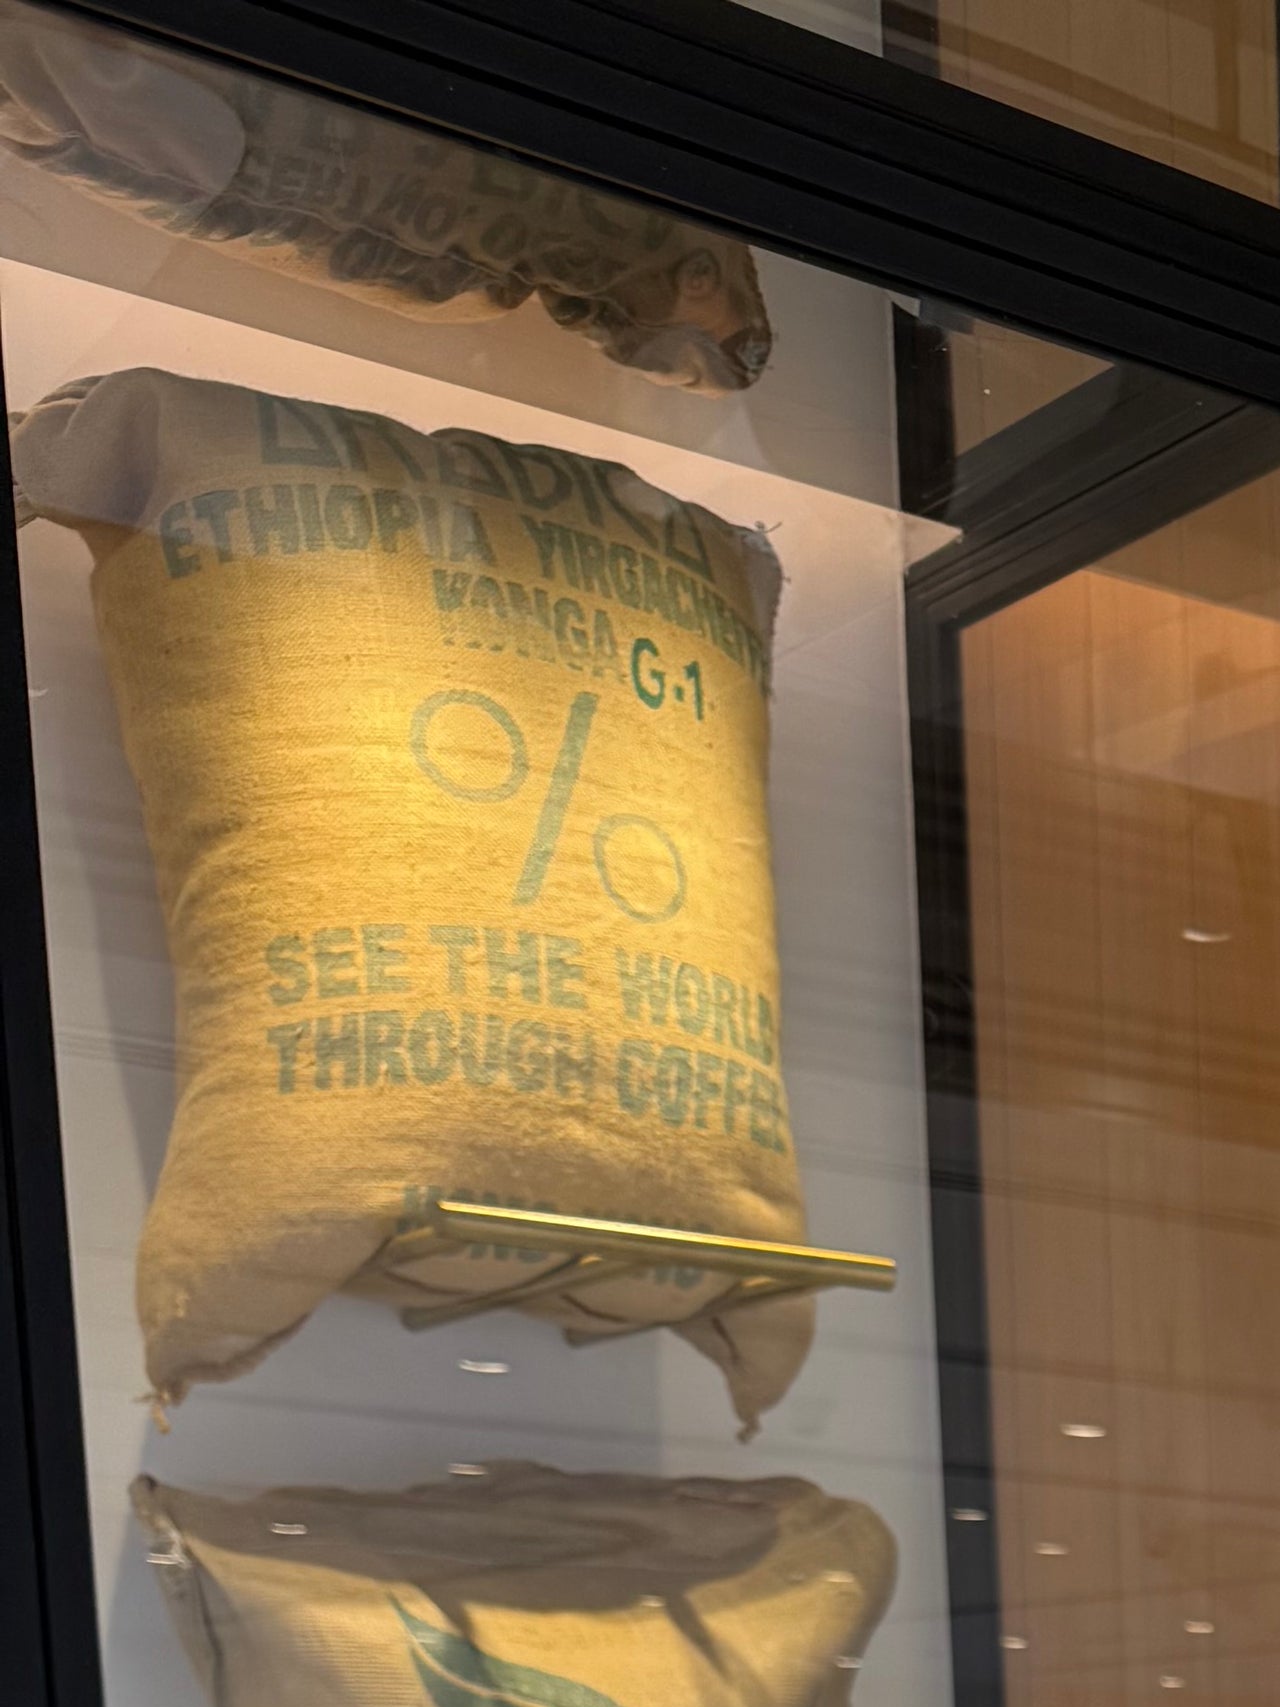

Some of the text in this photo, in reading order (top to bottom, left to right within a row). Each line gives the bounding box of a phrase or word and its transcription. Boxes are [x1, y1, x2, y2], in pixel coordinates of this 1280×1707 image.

[158, 482, 496, 580] ETHIOPIA
[264, 922, 774, 1066] SEE THE WORLD
[266, 1010, 787, 1154] THROUGH COFFEE
